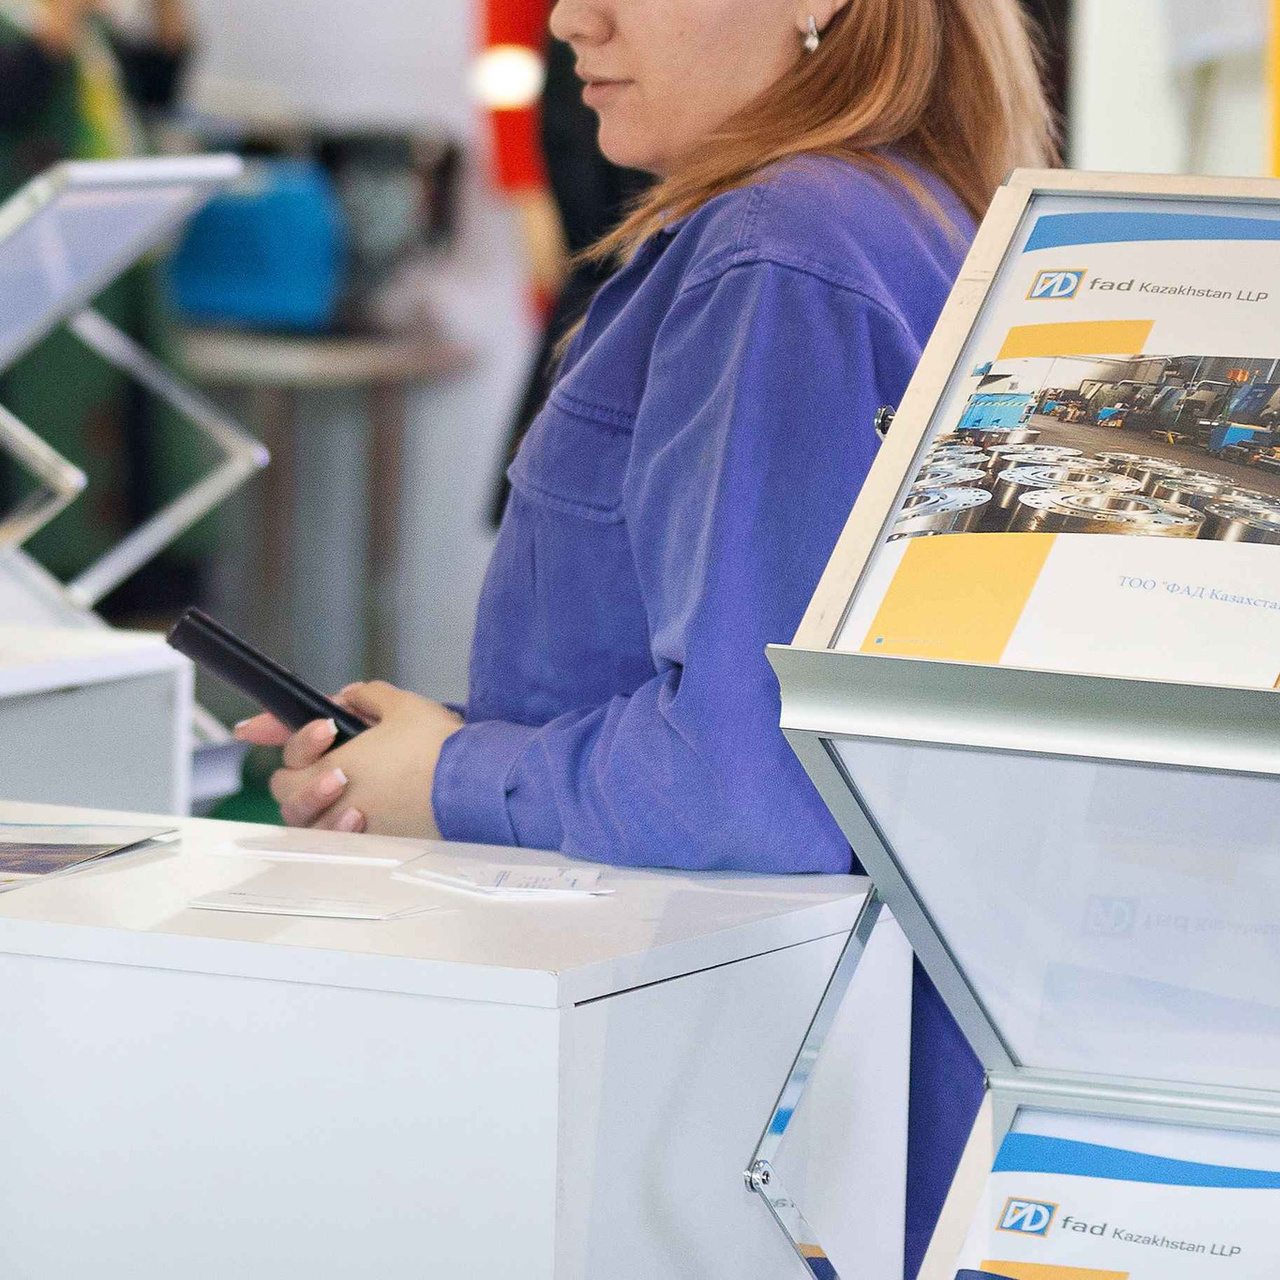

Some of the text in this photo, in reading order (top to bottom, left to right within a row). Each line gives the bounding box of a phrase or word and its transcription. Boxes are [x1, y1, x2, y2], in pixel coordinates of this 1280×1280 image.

[1089, 277, 1133, 292] fad
[1139, 281, 1232, 300] Kazakhstan
[1236, 289, 1269, 303] LLP
[1119, 575, 1156, 590] ТОО
[1209, 588, 1280, 610] Казахста
[1061, 1216, 1107, 1237] fad
[1112, 1227, 1206, 1255] Kazakhstan
[1209, 1242, 1241, 1258] LLP
